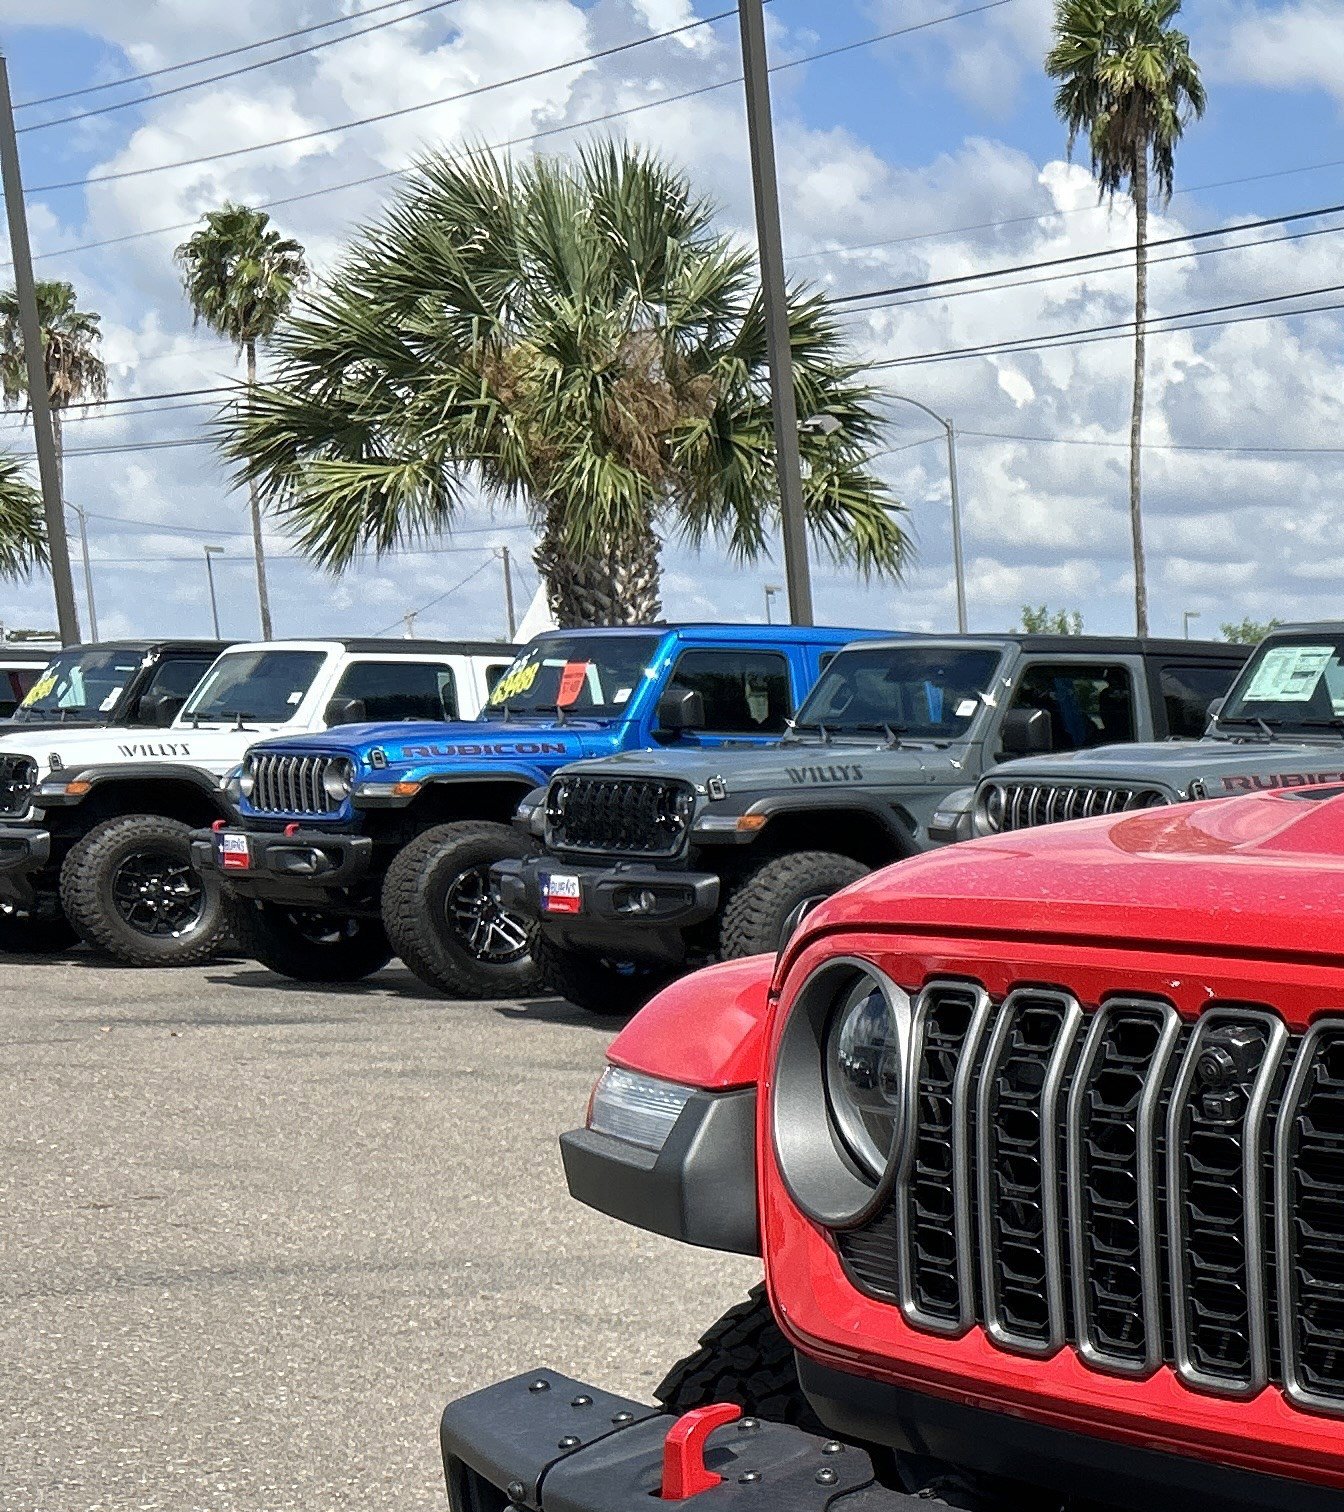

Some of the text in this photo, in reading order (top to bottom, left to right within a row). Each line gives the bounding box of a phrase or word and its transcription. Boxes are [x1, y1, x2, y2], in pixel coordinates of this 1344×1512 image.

[117, 743, 191, 757] WILLYS
[402, 743, 567, 758] RUBICON
[784, 765, 863, 784] WILLYS
